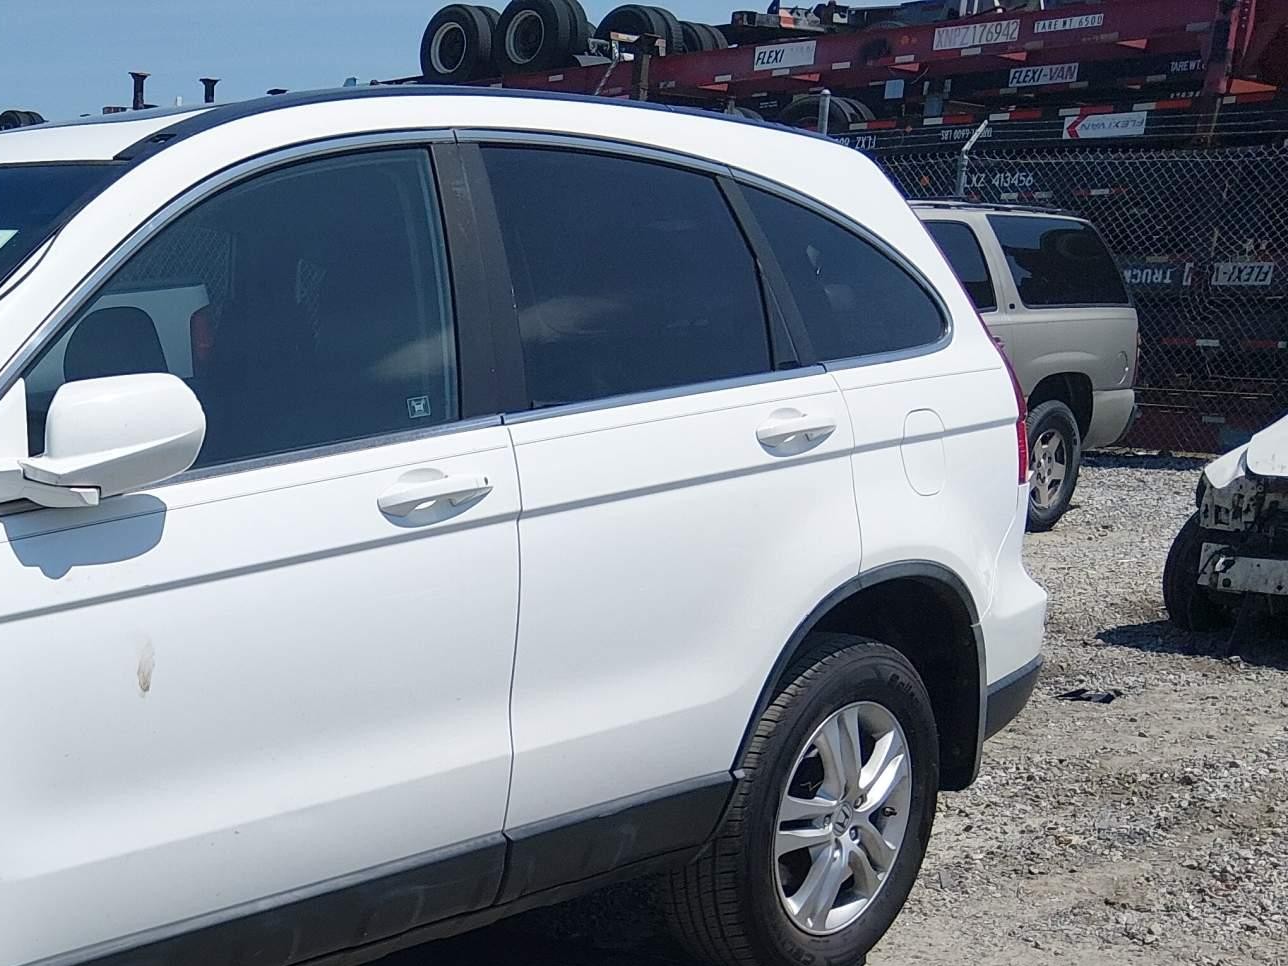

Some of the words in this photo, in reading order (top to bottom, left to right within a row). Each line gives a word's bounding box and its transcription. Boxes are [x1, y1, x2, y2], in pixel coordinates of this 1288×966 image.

[1036, 20, 1059, 31] TARE
[755, 48, 785, 66] FLEXI
[1010, 64, 1077, 84] FLEXI-VAN
[991, 172, 1034, 187] 413456
